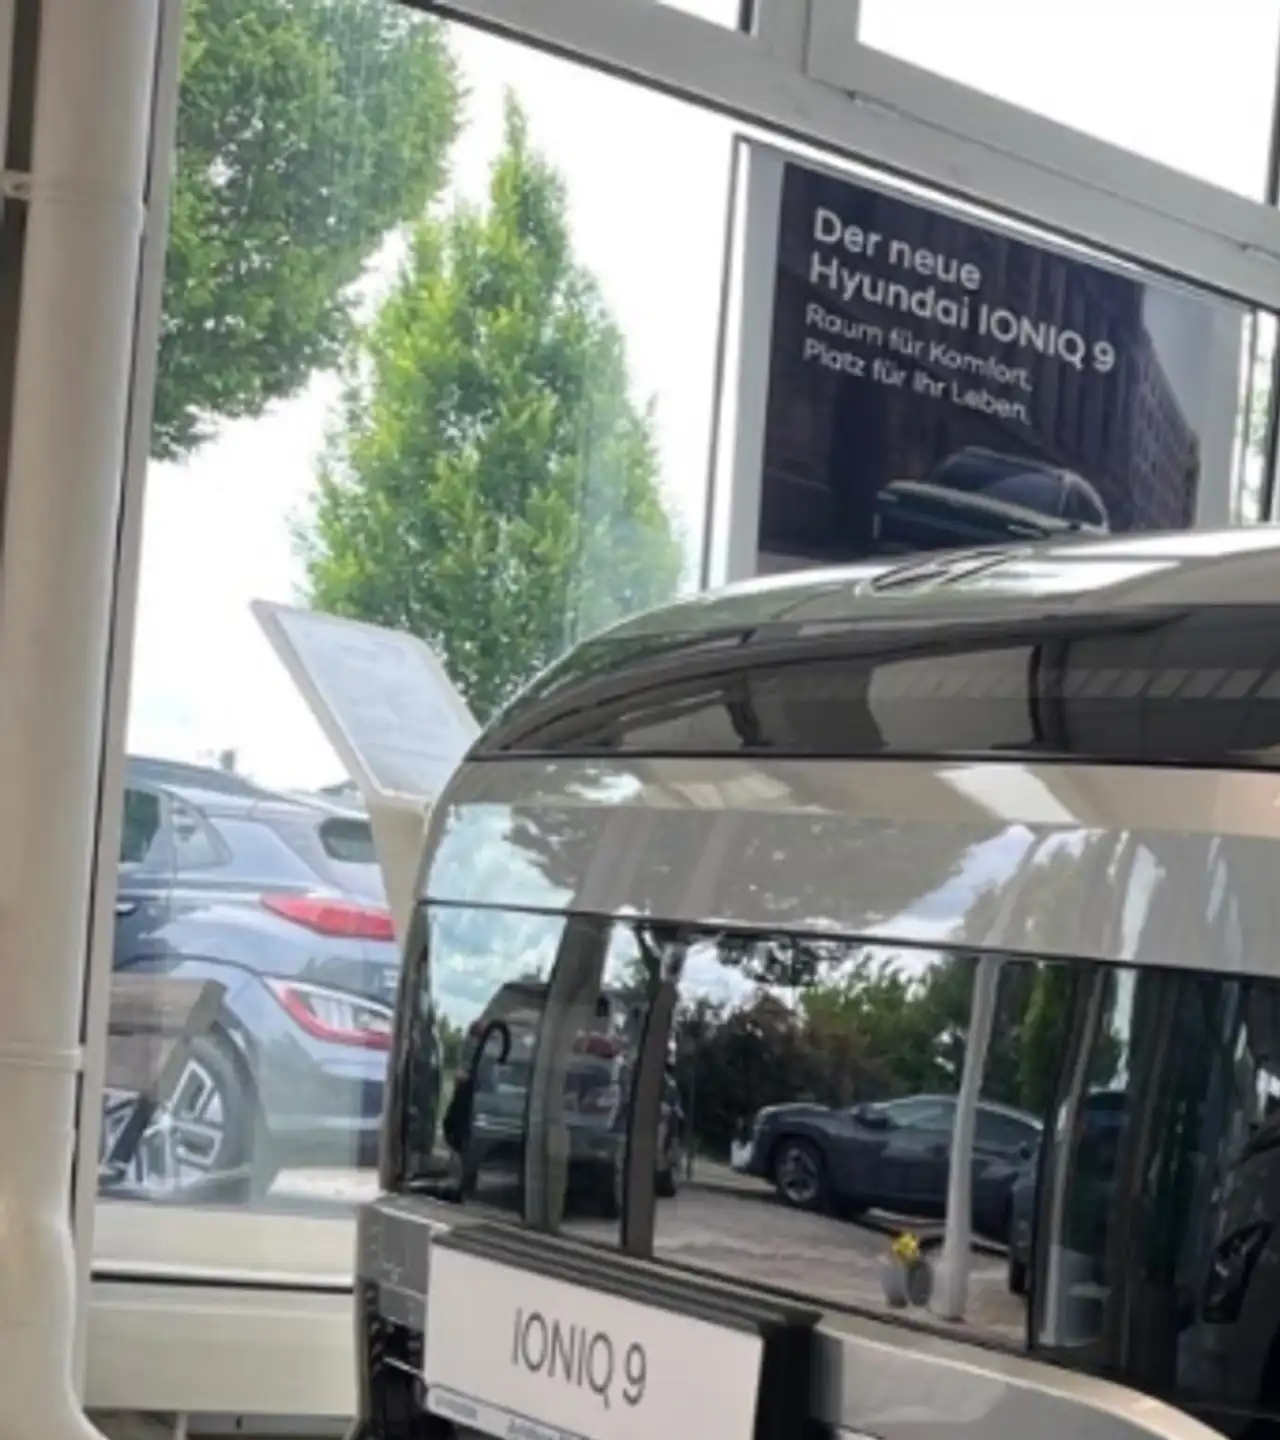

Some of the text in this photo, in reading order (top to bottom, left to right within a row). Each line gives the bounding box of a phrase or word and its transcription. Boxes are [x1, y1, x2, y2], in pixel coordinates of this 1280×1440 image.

[813, 206, 982, 291] Der neue
[805, 302, 884, 347] Raum
[888, 326, 926, 358] für
[809, 251, 1116, 373] Hyundai IONIQ 9
[802, 337, 866, 378] Platz
[872, 356, 908, 388] für
[912, 369, 947, 399] Ihr
[510, 1305, 647, 1411] IONIQ 9
